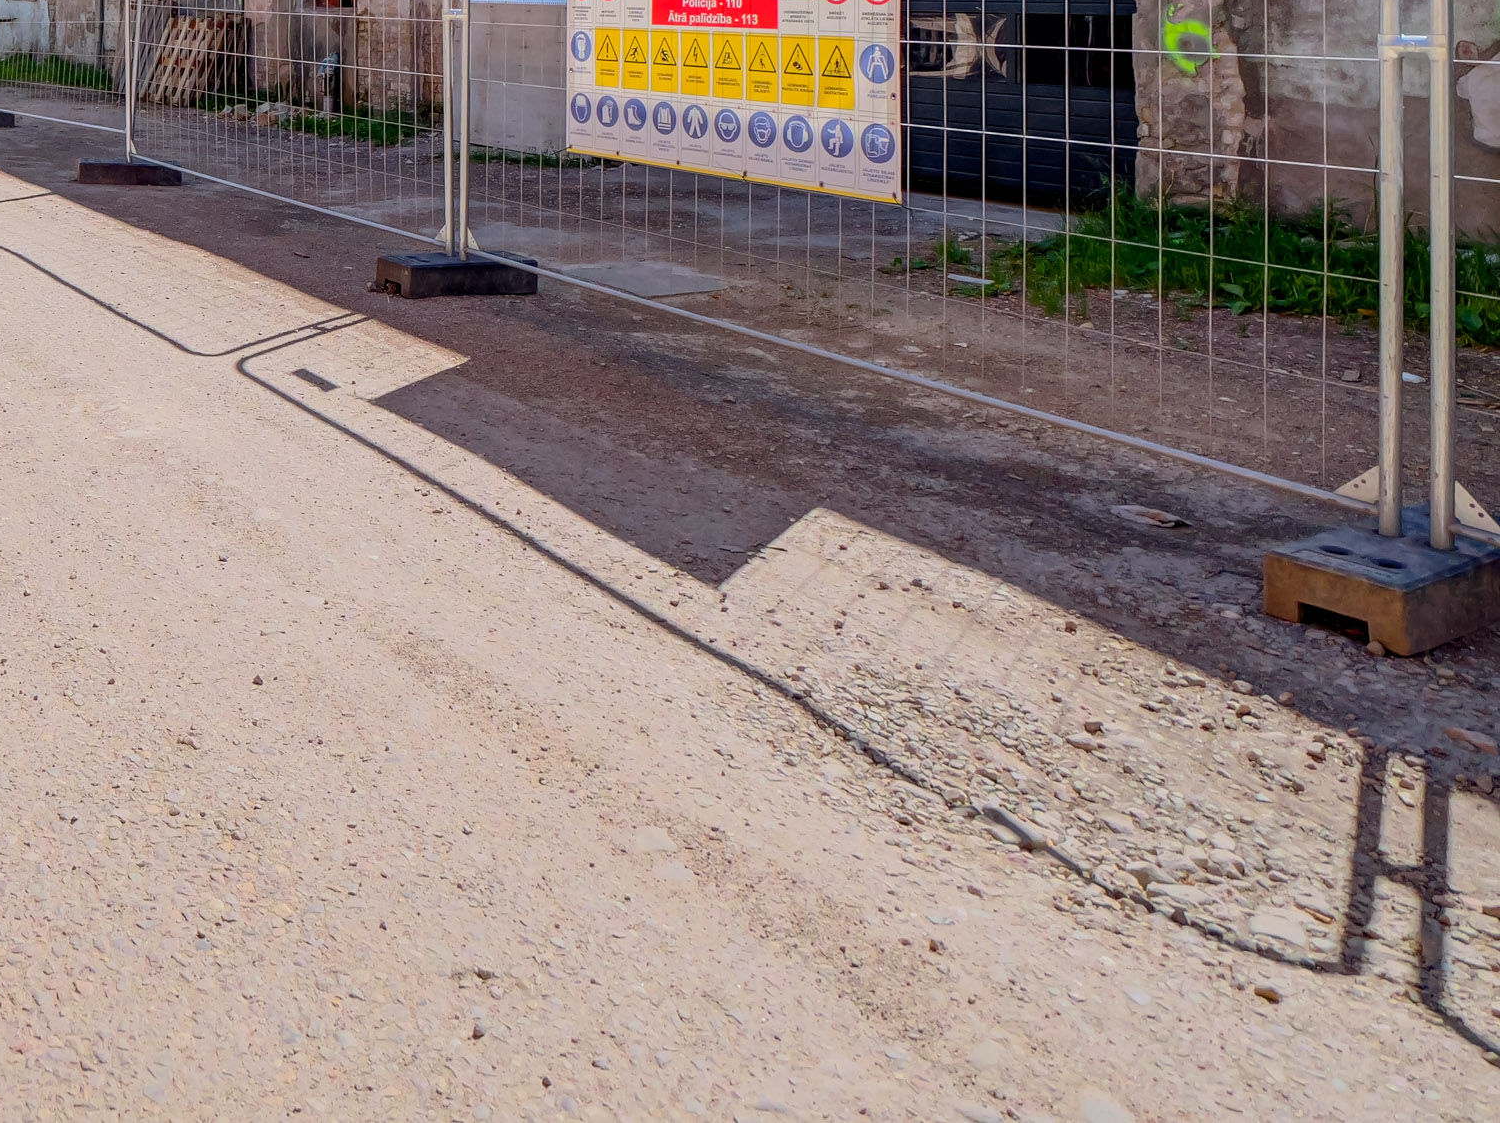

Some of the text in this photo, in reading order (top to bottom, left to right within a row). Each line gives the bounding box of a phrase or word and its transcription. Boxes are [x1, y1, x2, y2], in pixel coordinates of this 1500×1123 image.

[668, 10, 687, 23] Ātrā
[689, 12, 732, 25] palīdzība
[741, 14, 758, 25] 113
